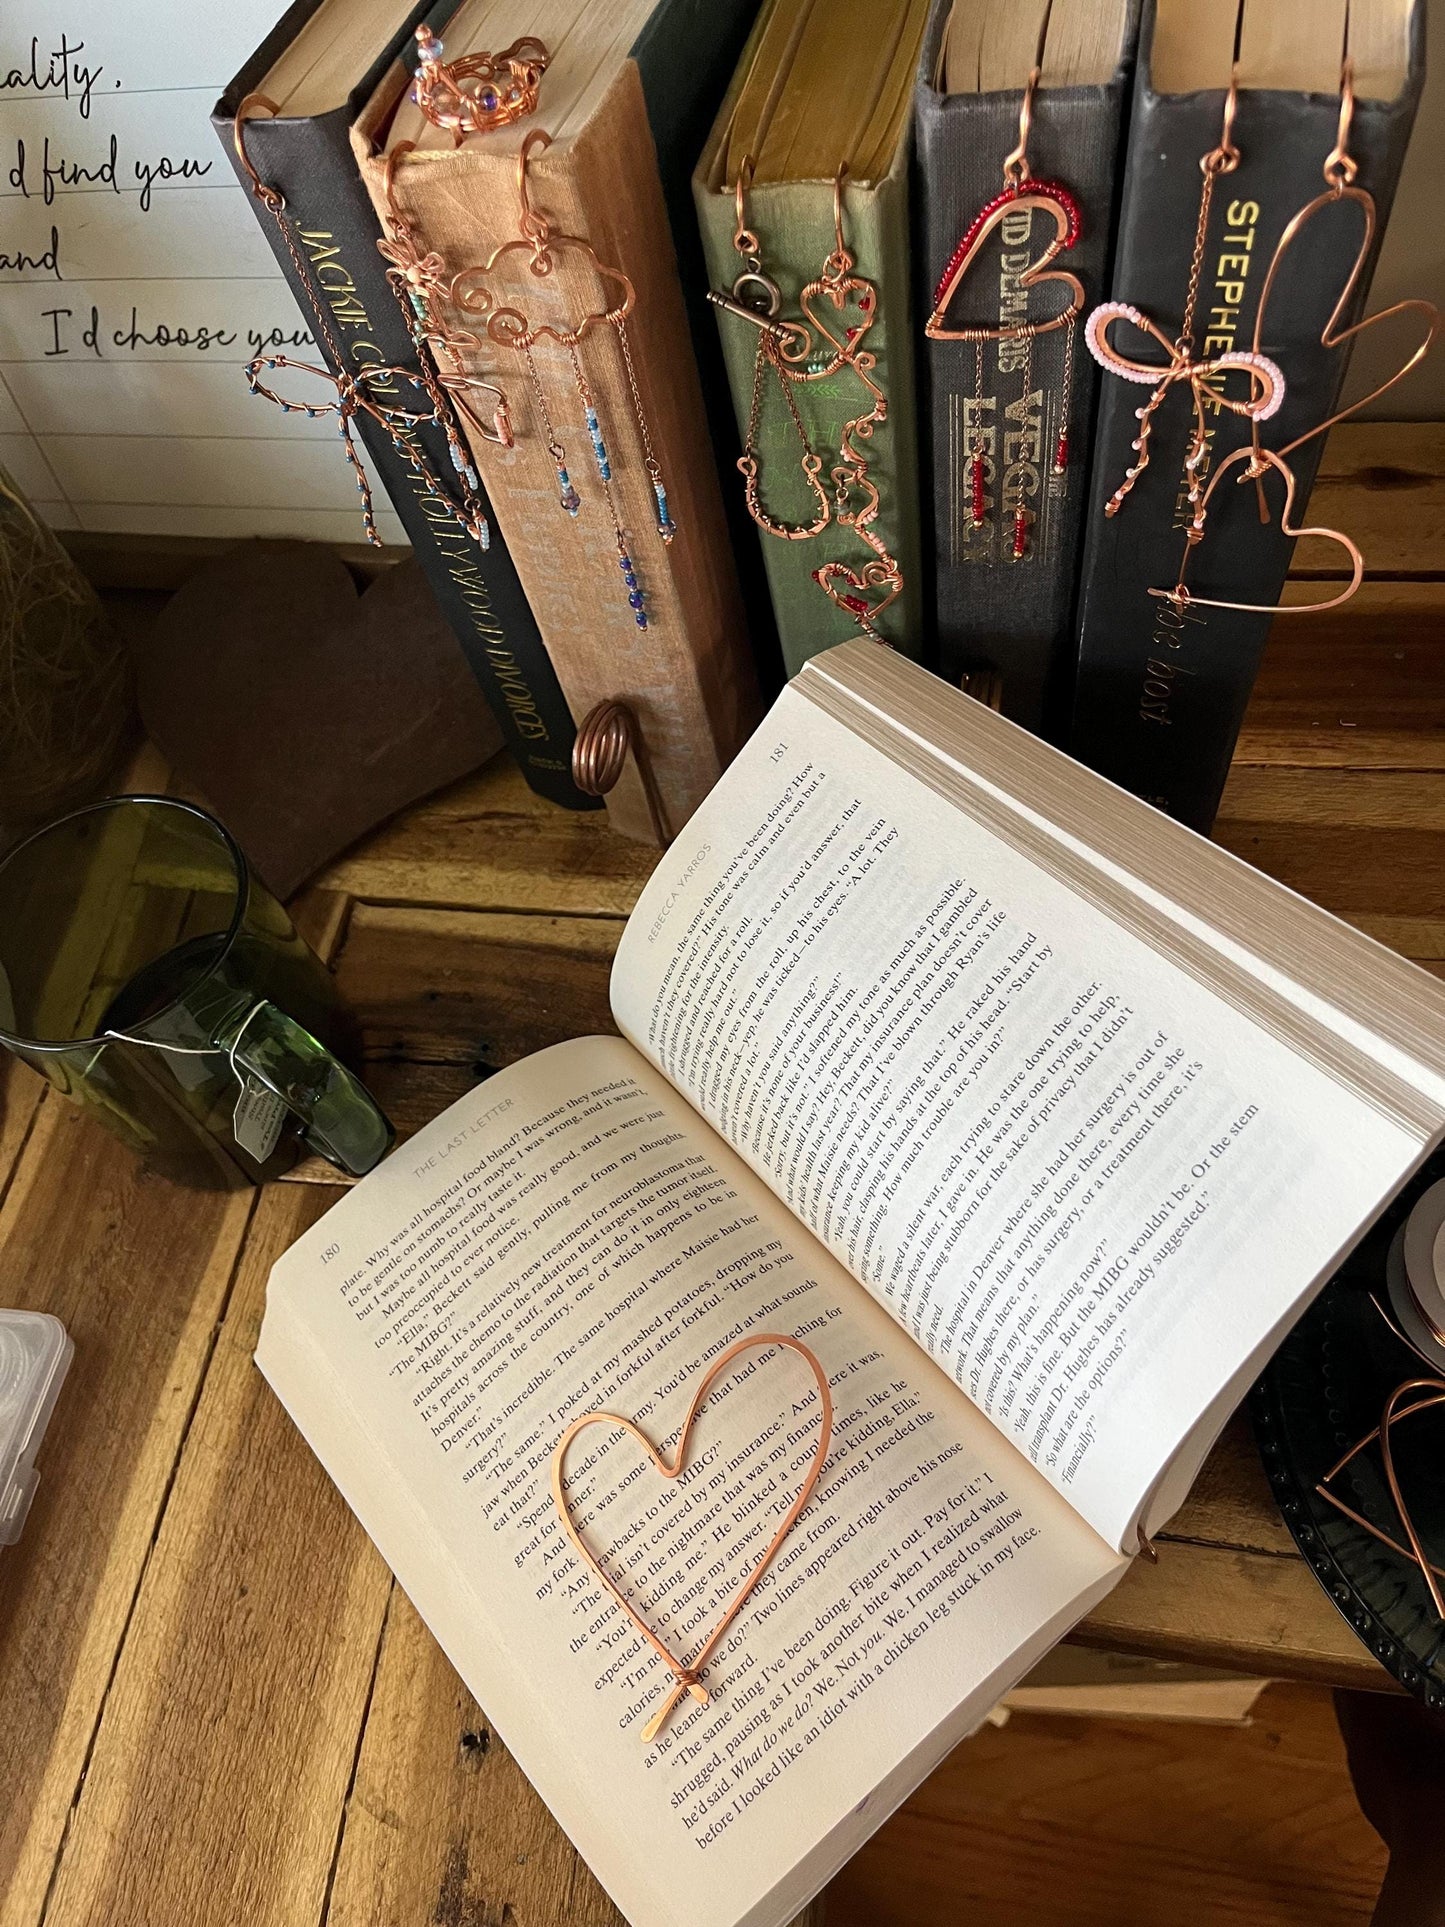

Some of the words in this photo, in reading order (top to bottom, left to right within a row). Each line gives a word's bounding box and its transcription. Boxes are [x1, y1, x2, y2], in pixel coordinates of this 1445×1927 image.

[43, 134, 121, 206] find
[135, 157, 213, 212] you
[0, 226, 63, 281] and
[997, 250, 1030, 373] DEMARIS
[114, 307, 237, 351] choose
[248, 328, 317, 358] you
[294, 218, 372, 331] JACKIE
[405, 470, 503, 642] HOLLYWOOD
[486, 650, 549, 742] DIVORCES
[769, 742, 789, 763] 181
[647, 892, 679, 944] REBECCA
[676, 843, 711, 887] YARROS
[690, 1038, 704, 1068] trying
[699, 1007, 715, 1038] really
[710, 980, 728, 1008] hard
[726, 962, 739, 982] not
[736, 950, 747, 962] to
[744, 927, 762, 949] lose
[759, 917, 773, 927] it,
[770, 901, 781, 914] so
[778, 888, 789, 900] if
[788, 860, 812, 892] you'd
[811, 823, 844, 861] answer,
[841, 799, 862, 821] that
[412, 1156, 437, 1178] THE
[438, 1130, 467, 1159] LAST
[469, 1098, 514, 1133] LETTER
[884, 1281, 895, 1296] We
[890, 1247, 905, 1281] waged
[902, 1240, 909, 1250] a
[906, 1208, 926, 1241] silent
[923, 1184, 943, 1207] war,
[941, 1154, 963, 1182] each
[959, 1116, 992, 1153] trying
[987, 1102, 1001, 1116] to
[999, 1071, 1025, 1102] stare
[1025, 1038, 1055, 1070] down
[1052, 1016, 1072, 1036] the
[1071, 981, 1102, 1015] other.
[945, 1290, 970, 1336] hospital
[964, 1280, 977, 1294] in
[972, 1235, 1005, 1280] Denver
[1002, 1198, 1032, 1234] where
[1030, 1176, 1049, 1199] she
[1044, 1149, 1069, 1176] had
[1064, 1128, 1086, 1152] her
[1085, 1083, 1126, 1130] surgery
[1121, 1071, 1137, 1083] is
[1135, 1048, 1155, 1070] out
[1154, 1030, 1168, 1048] of
[960, 1320, 978, 1347] That
[974, 1284, 999, 1322] means
[995, 1258, 1015, 1284] that
[1013, 1204, 1057, 1259] anything
[1053, 1173, 1080, 1204] done
[1077, 1139, 1112, 1172] there,
[1109, 1100, 1141, 1135] every
[1137, 1071, 1165, 1100] time
[1164, 1048, 1184, 1070] she
[320, 1242, 340, 1264] 180
[355, 1303, 374, 1321] but
[373, 1295, 380, 1305] I
[380, 1279, 399, 1297] was
[399, 1263, 417, 1280] too
[417, 1237, 446, 1264] numb
[445, 1226, 458, 1238] to
[458, 1200, 487, 1227] really
[487, 1180, 513, 1202] taste
[512, 1171, 526, 1181] it.
[397, 1313, 428, 1345] "Ella,"
[432, 1278, 472, 1316] Beckett
[473, 1255, 495, 1279] said
[497, 1228, 531, 1260] gently,
[532, 1195, 571, 1230] pulling
[571, 1181, 589, 1196] me
[590, 1162, 618, 1182] from
[619, 1151, 637, 1164] my
[1025, 1383, 1041, 1406] this
[1034, 1372, 1047, 1386] is
[1042, 1350, 1063, 1374] fine.
[1058, 1321, 1080, 1347] But
[1077, 1300, 1096, 1322] the
[1091, 1255, 1129, 1300] MIBG
[1127, 1201, 1176, 1255] wouldn't
[1170, 1183, 1194, 1201] be.
[1191, 1158, 1211, 1178] Or
[1209, 1136, 1231, 1158] the
[1229, 1104, 1259, 1136] stem
[389, 1354, 415, 1376] "The
[414, 1311, 455, 1356] MIBG?"
[1052, 1427, 1068, 1453] what
[1064, 1409, 1078, 1430] are
[1073, 1390, 1090, 1410] the
[1088, 1328, 1127, 1390] options?"
[670, 1751, 726, 1809] shrugged,
[724, 1707, 771, 1758] pausing
[769, 1693, 784, 1710] as
[781, 1682, 792, 1696] I
[791, 1658, 820, 1687] took
[819, 1612, 864, 1660] another
[862, 1591, 889, 1615] bite
[889, 1561, 923, 1591] when
[920, 1549, 931, 1562] I
[931, 1509, 980, 1555] realized
[979, 1491, 1008, 1513] what
[671, 1741, 702, 1766] "The
[702, 1711, 732, 1743] same
[731, 1680, 765, 1713] thing
[760, 1658, 785, 1683] I've
[783, 1630, 815, 1660] been
[815, 1597, 851, 1631] doing.
[848, 1558, 890, 1597] Figure
[887, 1547, 901, 1561] it
[901, 1529, 926, 1550] out.
[923, 1506, 948, 1529] Pay
[946, 1492, 967, 1510] for
[964, 1477, 981, 1496] it."
[982, 1472, 994, 1483] I
[695, 1811, 734, 1849] before
[731, 1800, 742, 1814] I
[738, 1761, 781, 1807] looked
[777, 1742, 803, 1768] like
[803, 1726, 820, 1745] an
[816, 1698, 848, 1729] idiot
[846, 1672, 875, 1700] with
[874, 1664, 884, 1675] a
[883, 1621, 929, 1666] chicken
[925, 1602, 951, 1623] leg
[947, 1572, 981, 1605] stuck
[977, 1561, 995, 1576] in
[993, 1544, 1014, 1564] my
[1011, 1527, 1041, 1549] face.
